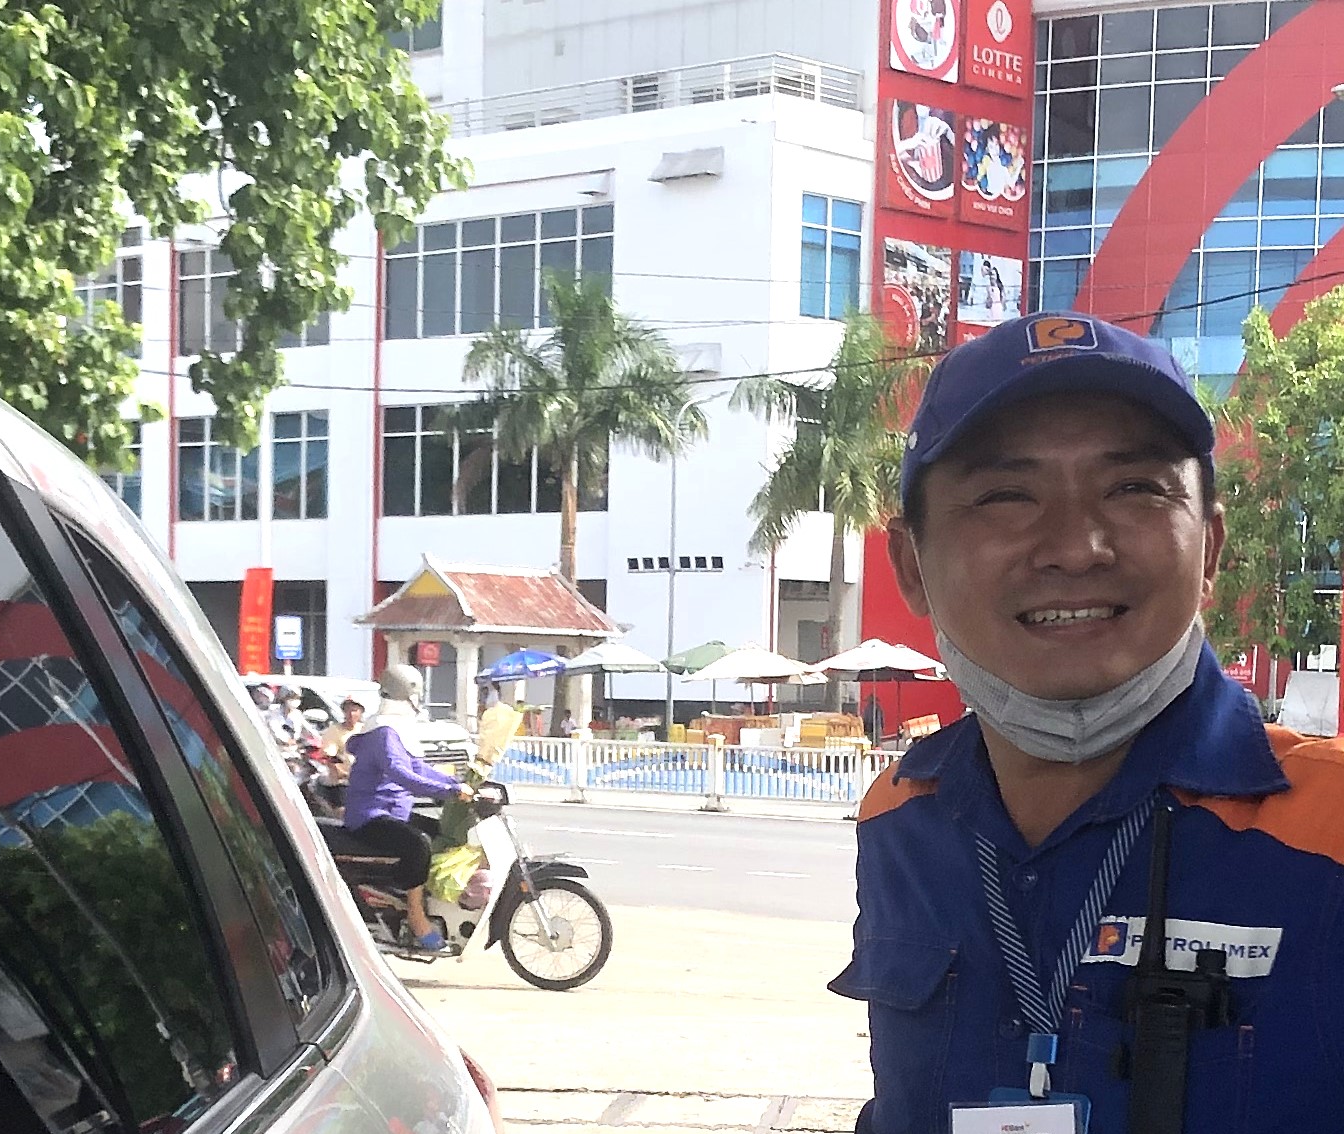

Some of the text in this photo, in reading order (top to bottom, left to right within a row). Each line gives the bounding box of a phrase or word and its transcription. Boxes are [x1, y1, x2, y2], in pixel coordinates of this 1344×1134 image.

[972, 44, 1023, 73] LOTTE
[972, 63, 1023, 85] CINEMA
[1131, 934, 1273, 959] PROIMEX
